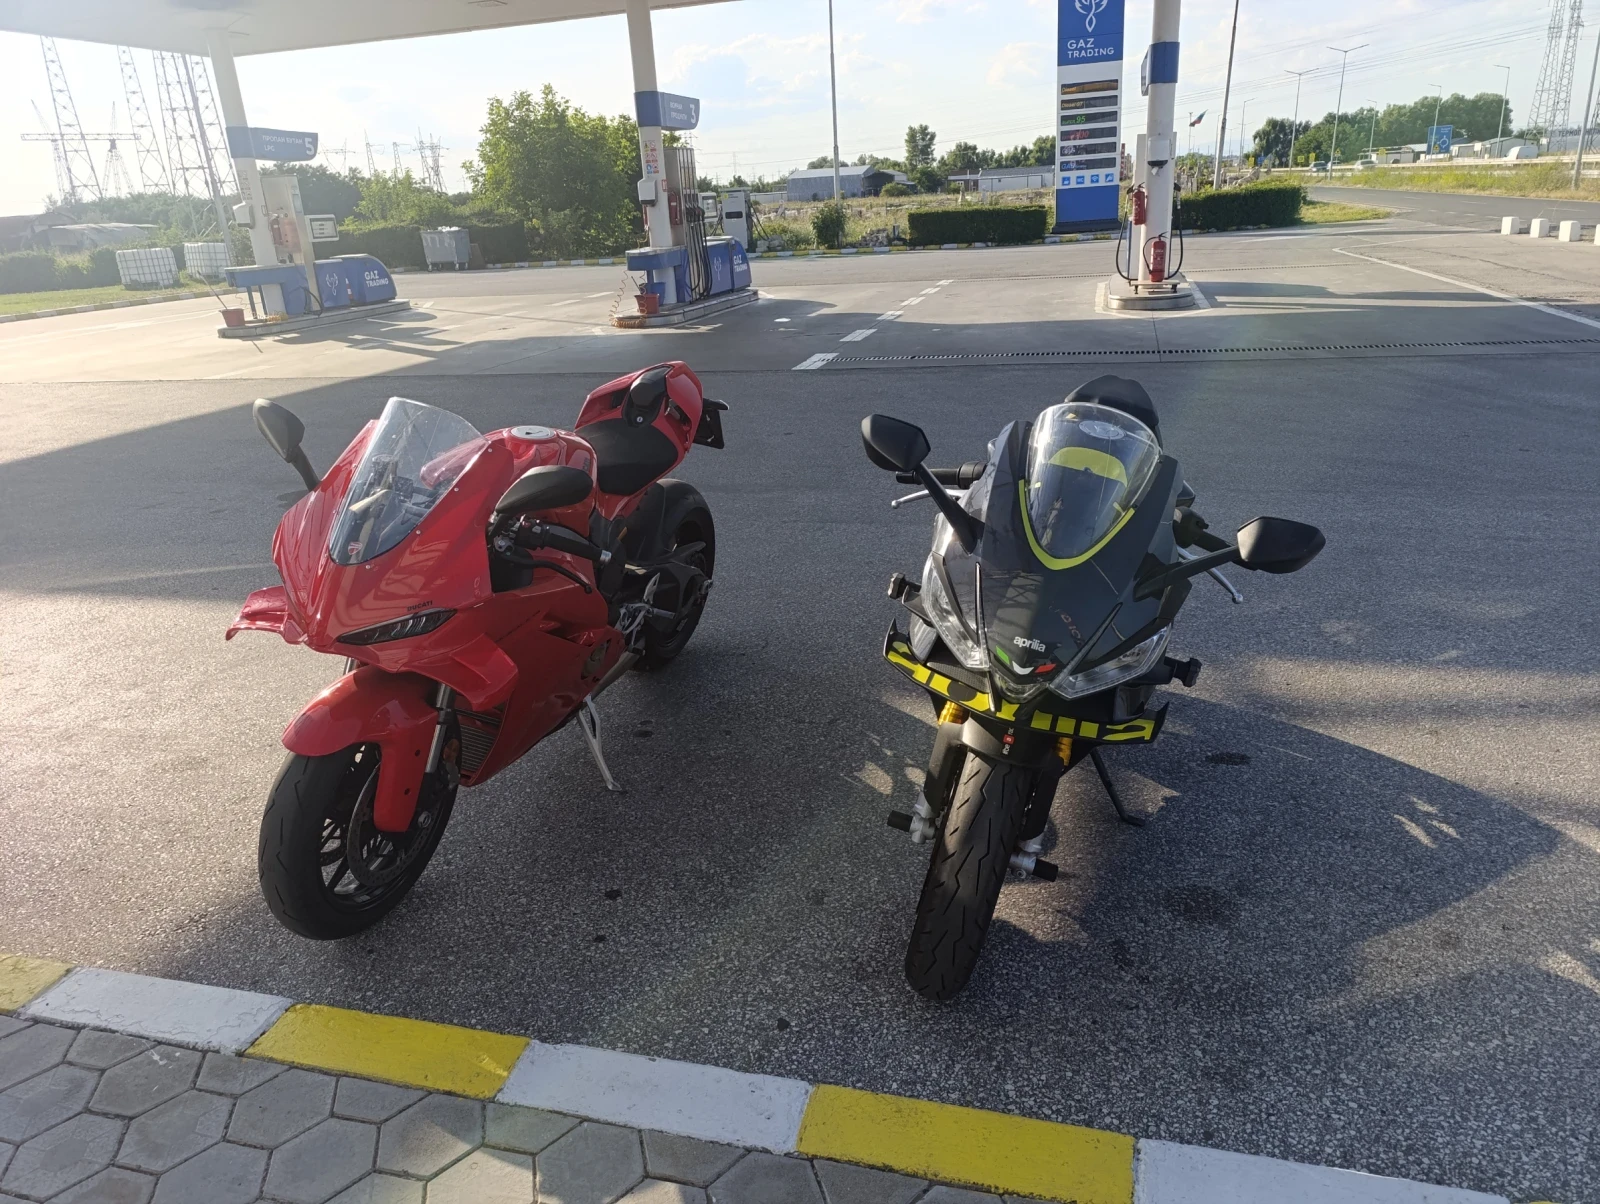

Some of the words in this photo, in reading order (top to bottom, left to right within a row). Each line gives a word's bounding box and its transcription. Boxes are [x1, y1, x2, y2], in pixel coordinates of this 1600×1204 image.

[1067, 38, 1095, 50] GAZ
[1067, 47, 1115, 59] TRADING
[689, 103, 697, 124] 3
[1076, 115, 1086, 124] 95
[304, 137, 315, 156] 5
[733, 254, 743, 265] GAZ
[364, 270, 380, 281] GAZ
[365, 277, 389, 288] TRADING
[407, 600, 433, 612] DUCATI
[1013, 635, 1046, 653] aprilia
